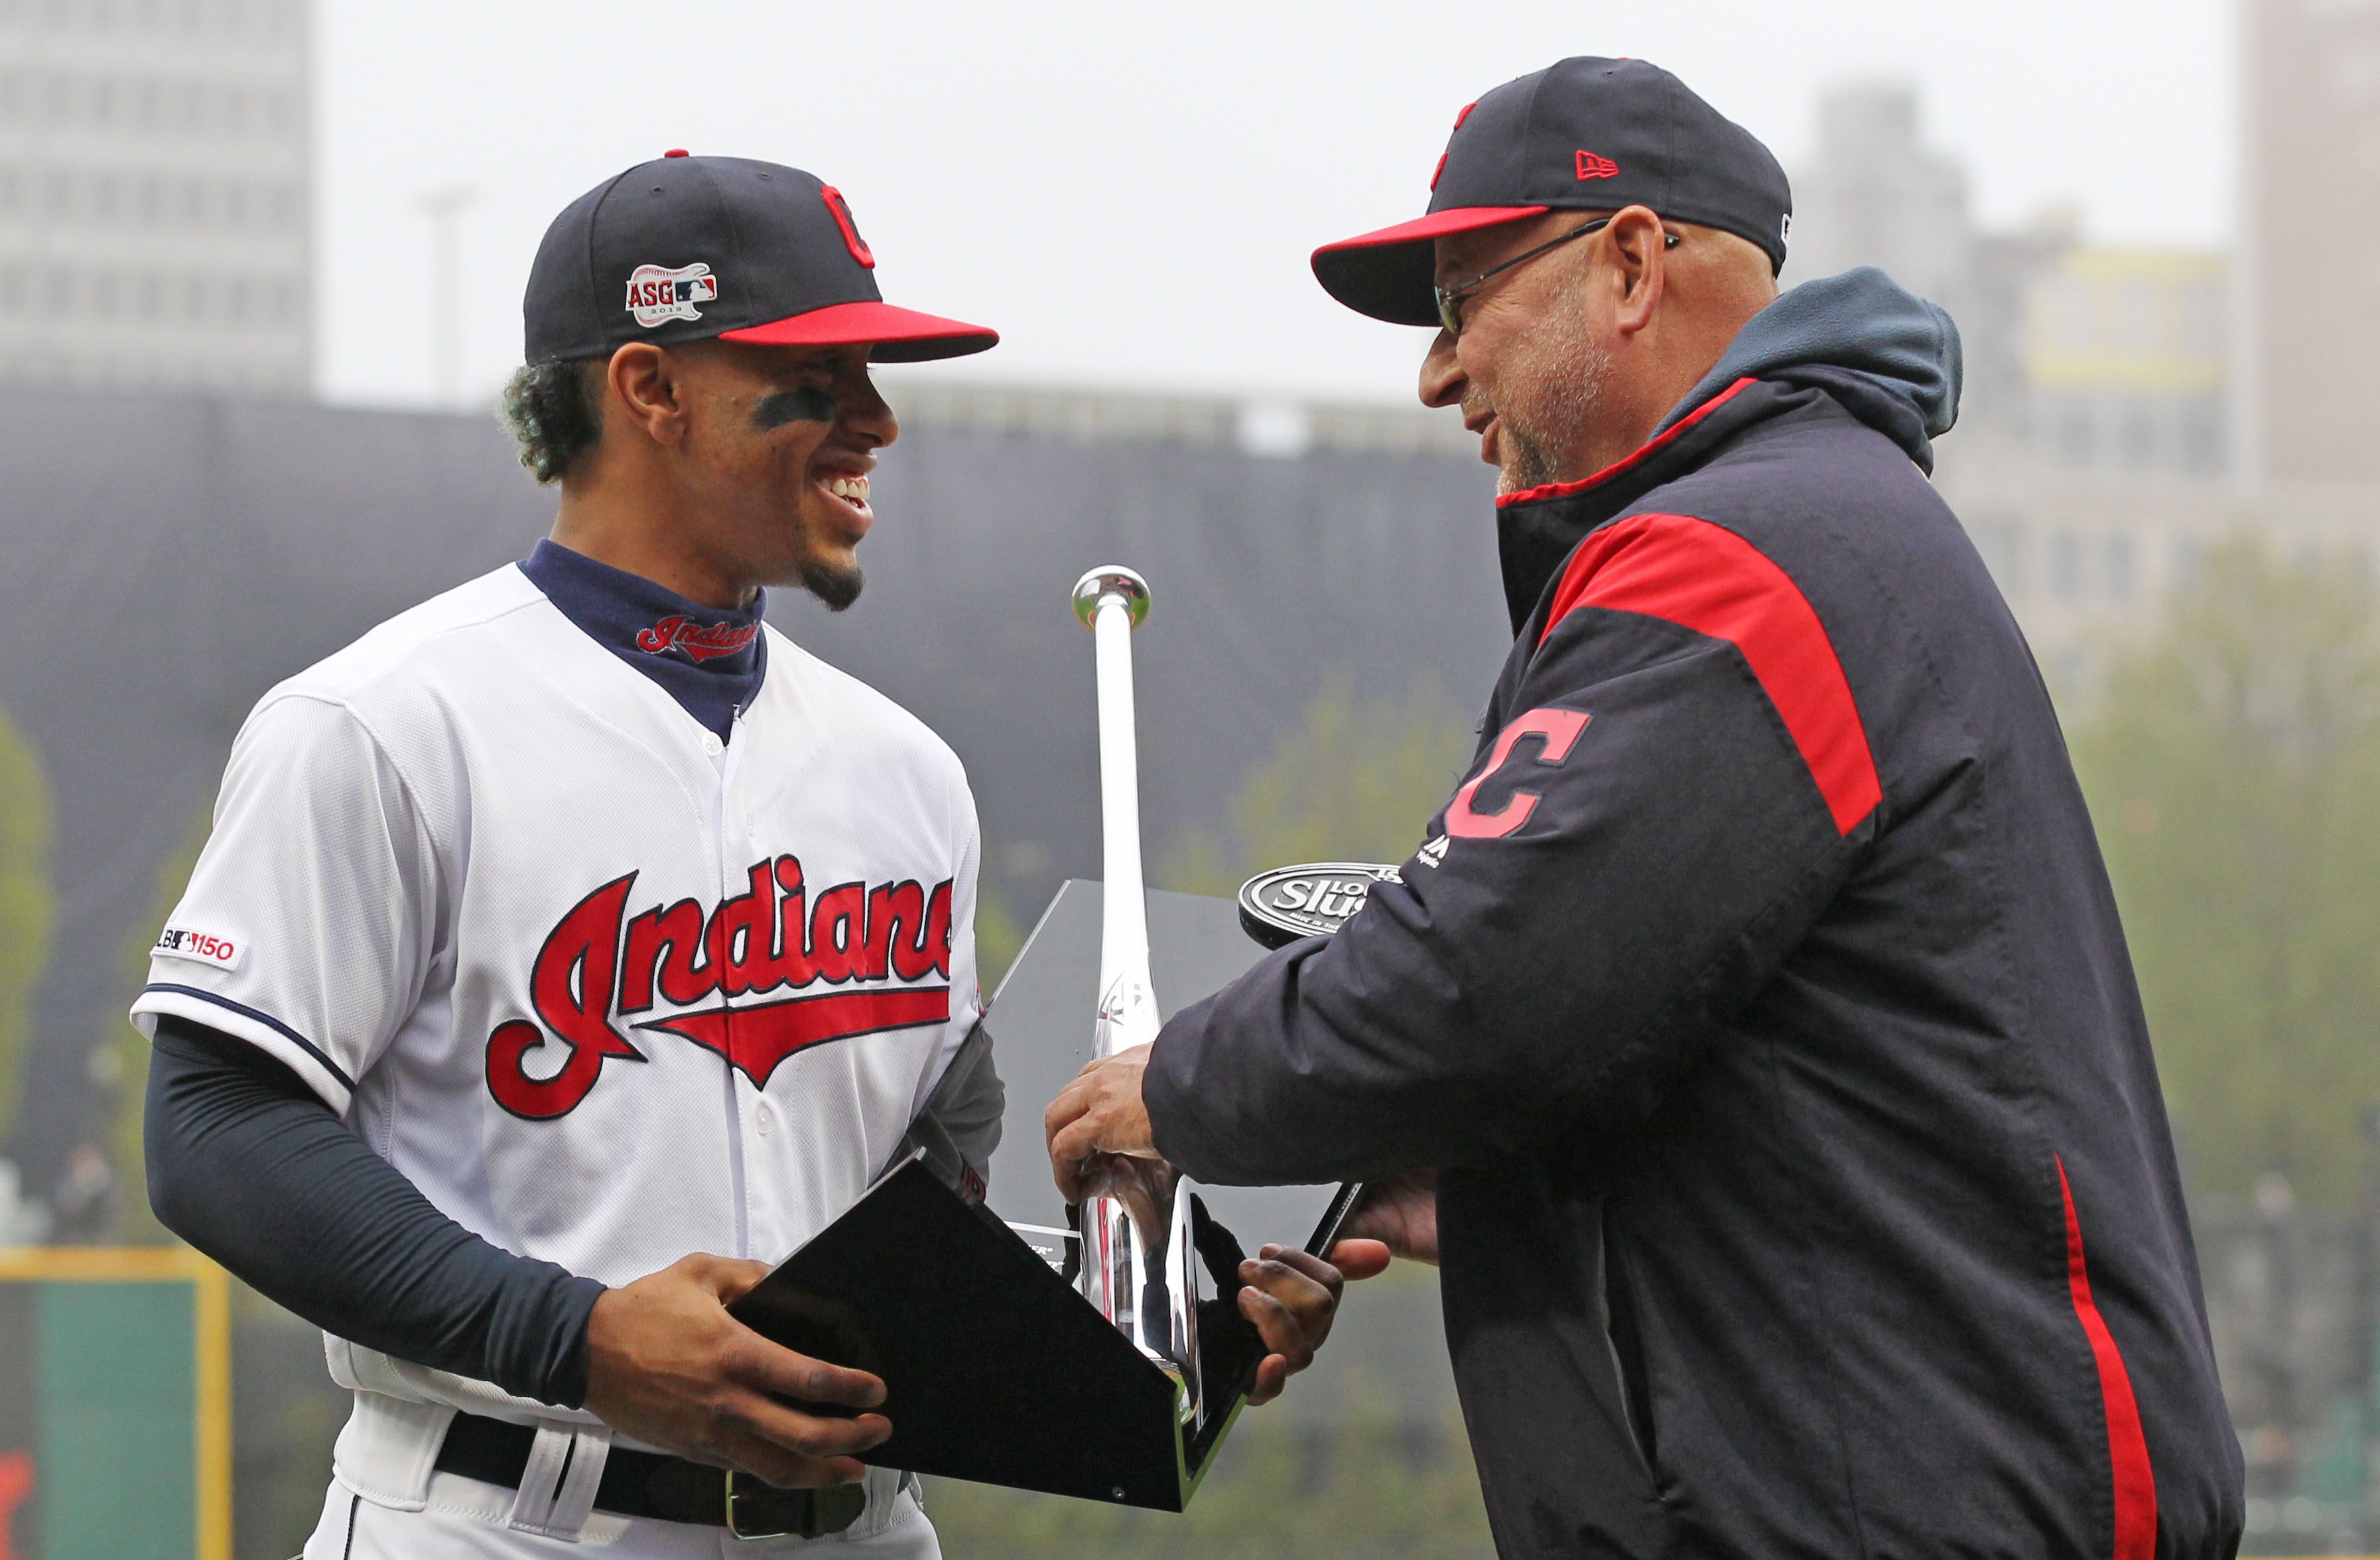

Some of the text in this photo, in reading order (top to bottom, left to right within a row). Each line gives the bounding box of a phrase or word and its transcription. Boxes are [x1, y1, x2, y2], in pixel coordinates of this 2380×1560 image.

[629, 280, 674, 308] ASG
[651, 306, 682, 314] 2019
[1445, 708, 1593, 838] C
[1329, 880, 1369, 897] LO
[197, 935, 234, 960] 150
[486, 854, 953, 1120] Indian
